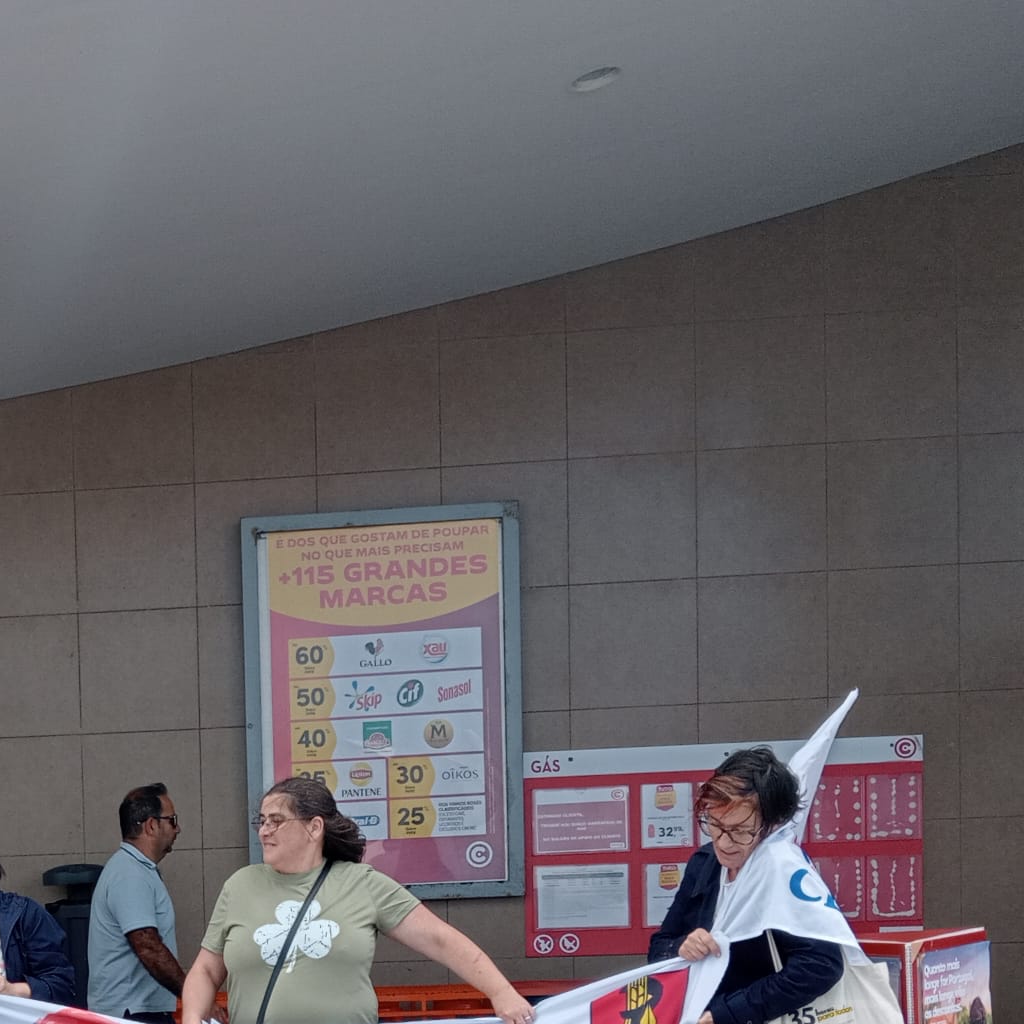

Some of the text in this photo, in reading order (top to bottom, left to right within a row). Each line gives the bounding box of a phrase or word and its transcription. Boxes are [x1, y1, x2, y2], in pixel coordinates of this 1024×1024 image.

[287, 537, 315, 548] DOS
[319, 535, 347, 548] QUE
[351, 530, 408, 544] GOSTAM
[411, 529, 429, 540] DE
[432, 524, 489, 537] POUPAR
[301, 541, 464, 562] NO QUE MAIS PRECISAM
[278, 554, 488, 586] +115 GRANDES
[319, 582, 448, 609] MARCAS
[359, 658, 392, 668] GALLO
[296, 687, 325, 707] 50
[437, 679, 472, 702] Sonasol
[297, 728, 326, 748] 40
[396, 764, 424, 784] 30
[531, 755, 561, 773] GÁS
[341, 787, 382, 799] PANTENE
[397, 807, 425, 827] 25
